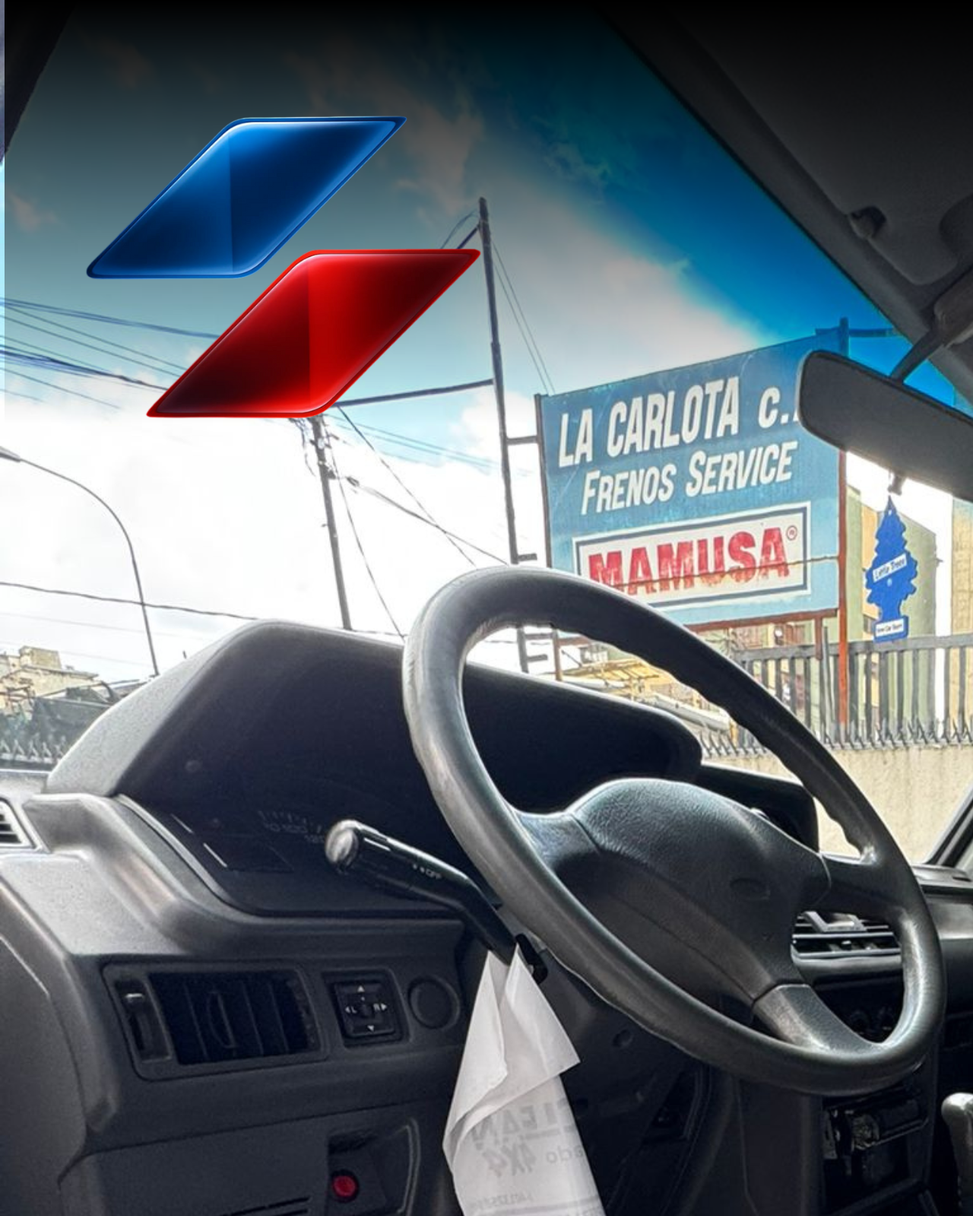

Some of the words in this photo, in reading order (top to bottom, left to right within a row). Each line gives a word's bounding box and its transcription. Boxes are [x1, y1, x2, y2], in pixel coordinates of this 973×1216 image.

[558, 408, 594, 468] LA
[606, 376, 740, 458] CARLOTA
[580, 469, 678, 516] FRENOS
[685, 440, 798, 498] SERVICE
